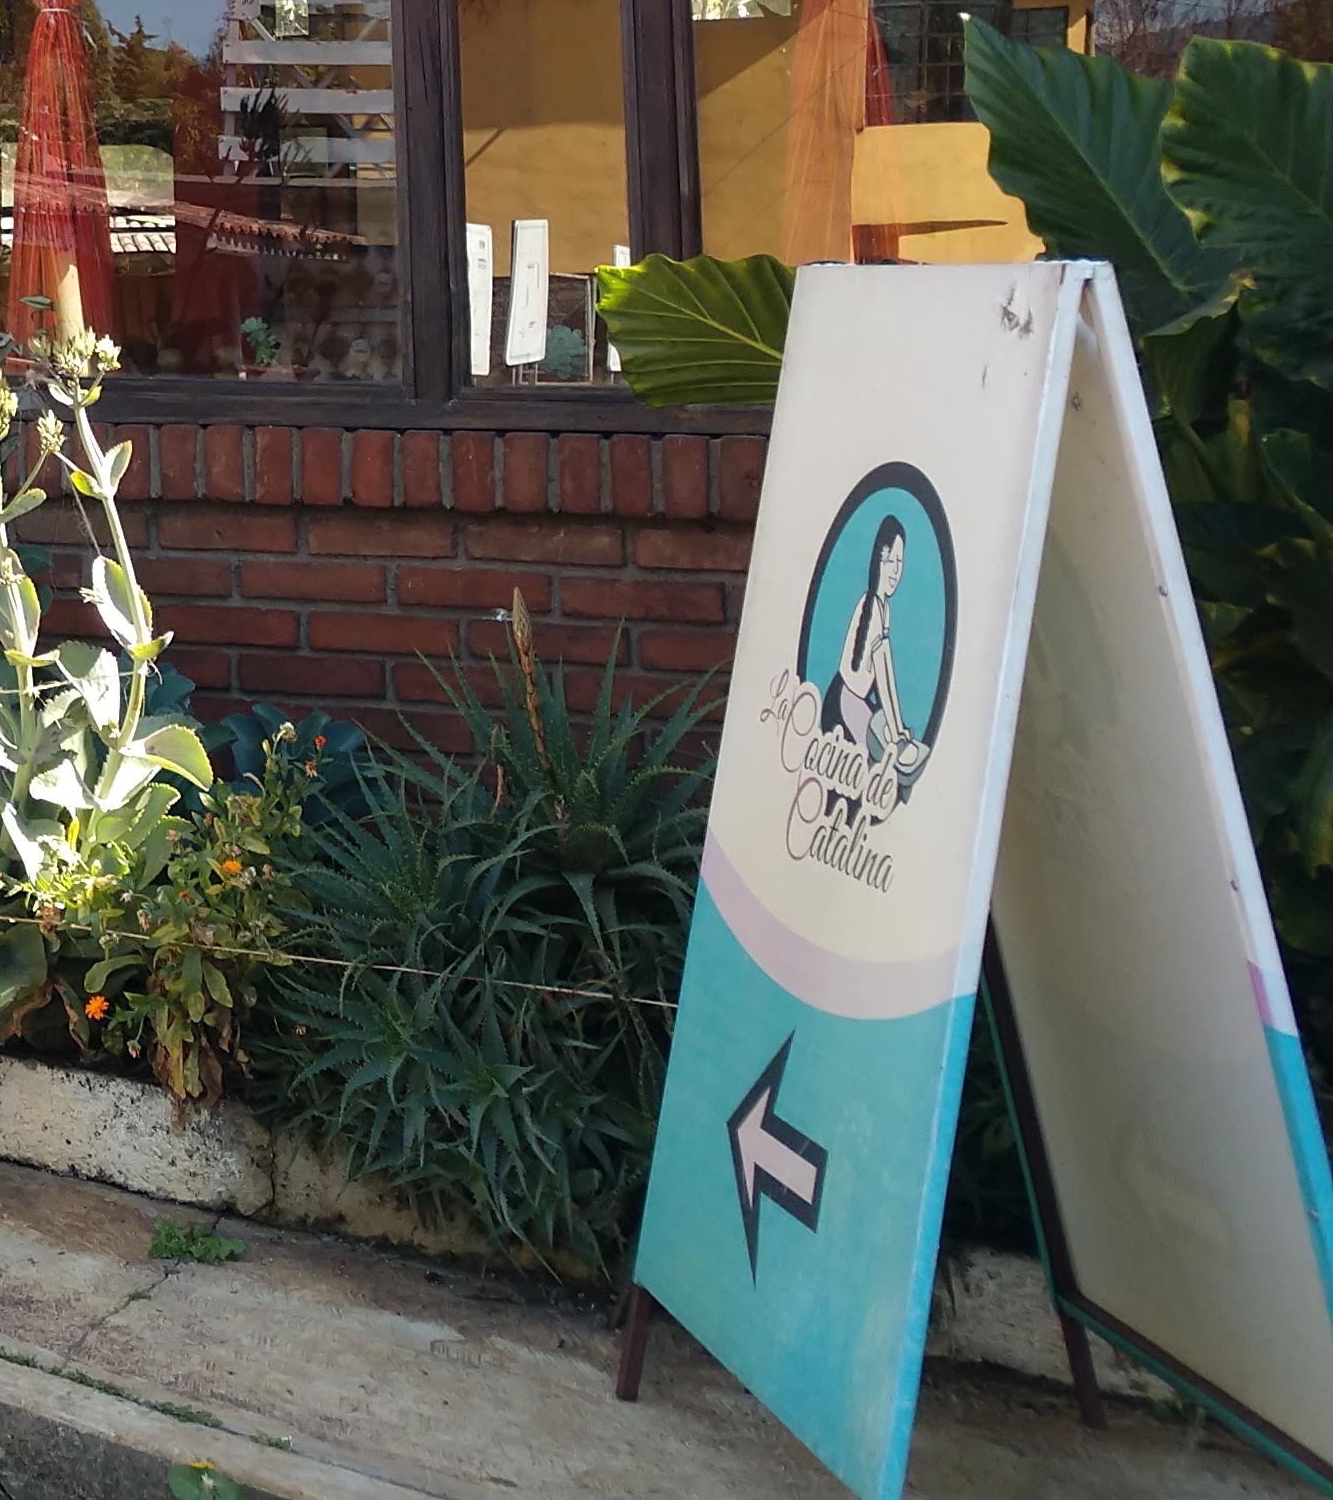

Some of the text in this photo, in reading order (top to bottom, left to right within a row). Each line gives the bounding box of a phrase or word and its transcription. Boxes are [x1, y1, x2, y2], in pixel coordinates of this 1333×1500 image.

[760, 668, 790, 725] La
[781, 689, 895, 811] Cocina de
[786, 774, 895, 893] Catalina
